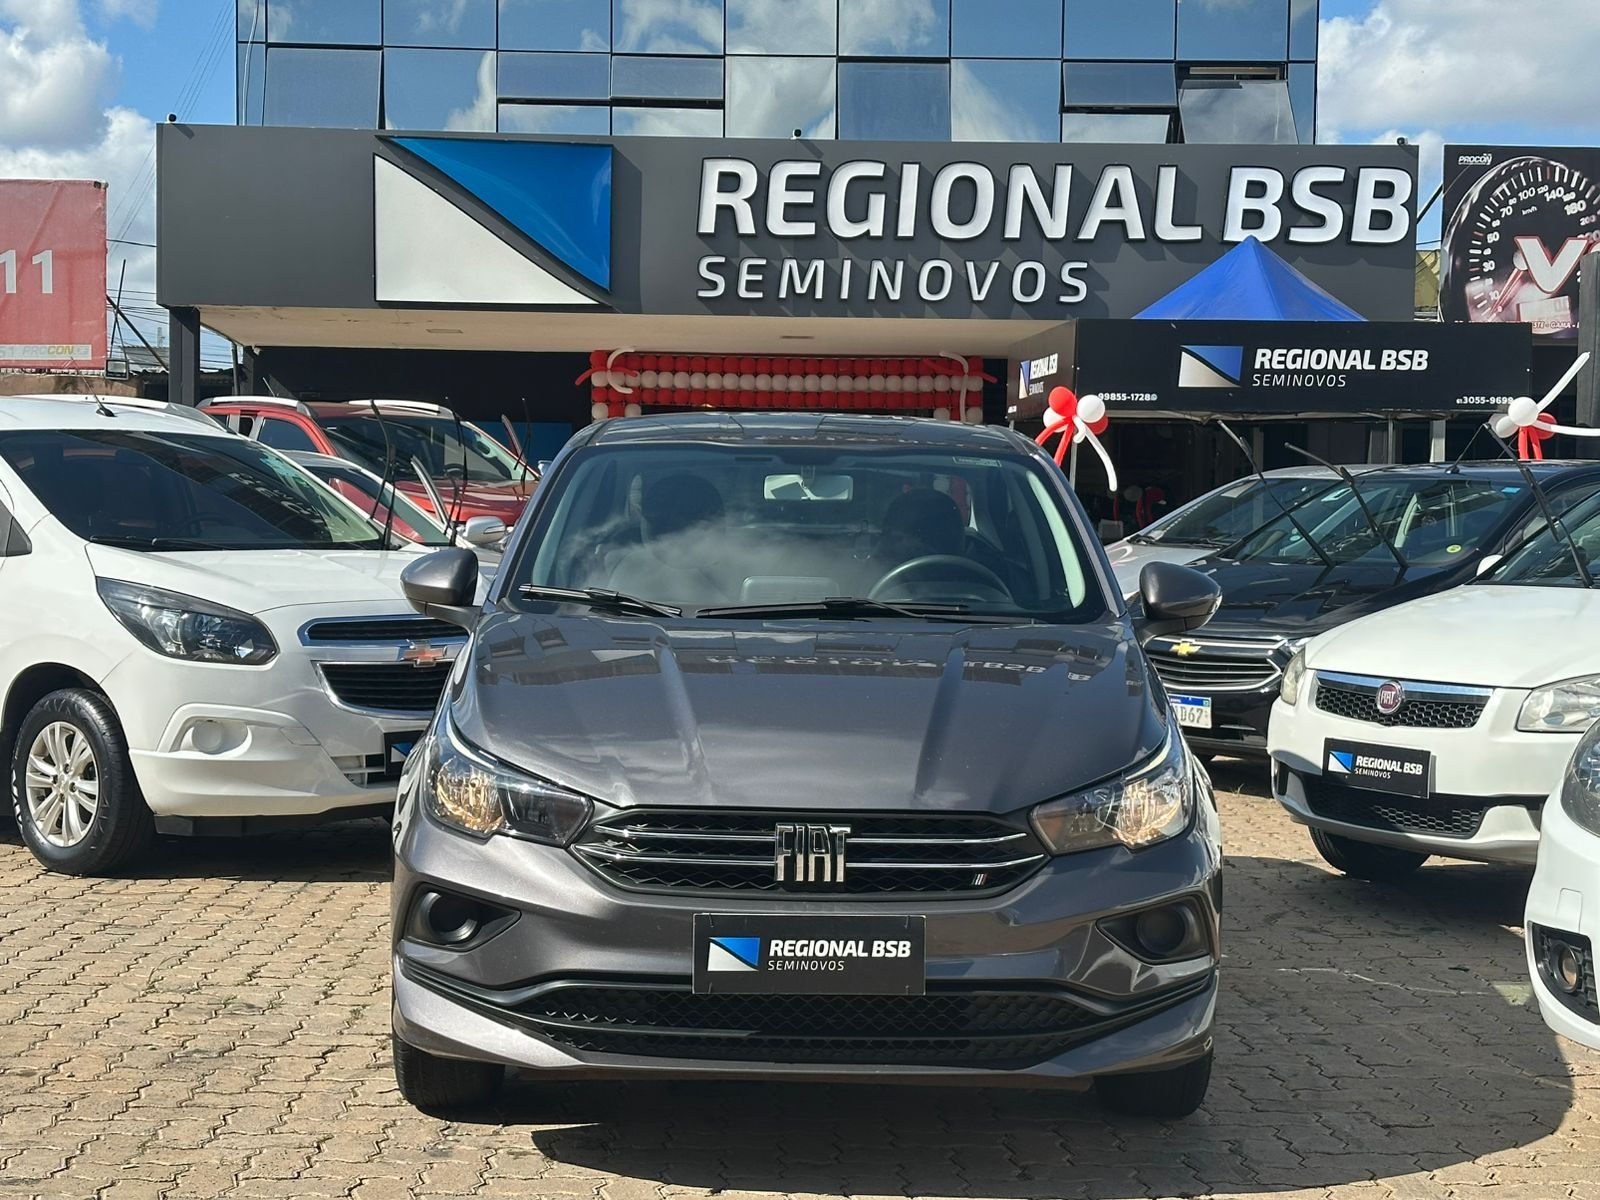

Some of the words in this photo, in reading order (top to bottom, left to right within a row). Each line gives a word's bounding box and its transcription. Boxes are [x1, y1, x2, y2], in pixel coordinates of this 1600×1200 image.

[1458, 153, 1492, 165] PROCON
[697, 157, 1202, 241] REGIONAL
[1222, 165, 1413, 243] BSB
[1518, 187, 1536, 200] 100
[1544, 187, 1565, 202] 140
[1500, 205, 1513, 217] 70
[697, 256, 1088, 303] SEMINOVOS
[1254, 348, 1376, 370] REGIONAL
[1380, 349, 1429, 371] BSB
[1252, 374, 1346, 387] SEMINOVOS
[1356, 755, 1402, 773] REGIONAL
[1403, 763, 1423, 775] BSB
[1354, 767, 1391, 779] SEMINOVOS
[775, 824, 851, 882] FIAT
[769, 940, 869, 958] REGIONAL
[871, 940, 911, 958] BSB
[768, 960, 845, 971] SEMINOVOS
